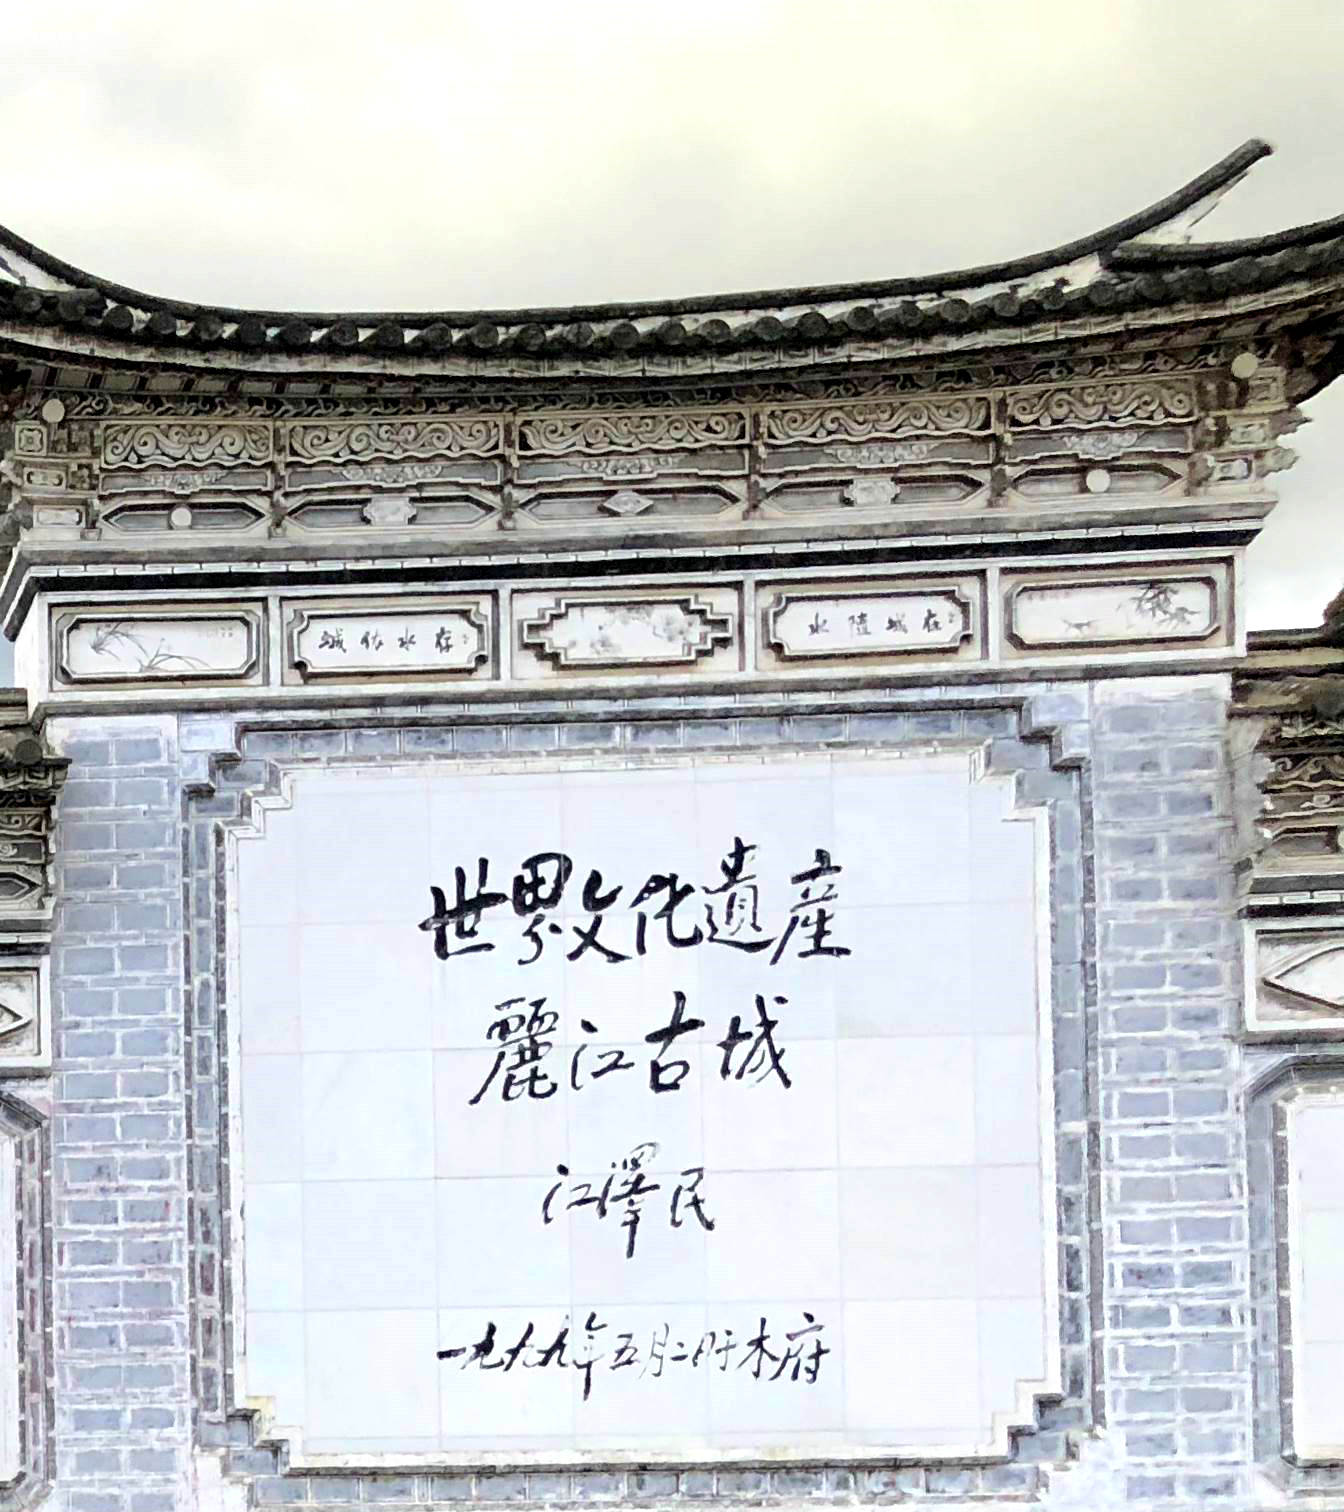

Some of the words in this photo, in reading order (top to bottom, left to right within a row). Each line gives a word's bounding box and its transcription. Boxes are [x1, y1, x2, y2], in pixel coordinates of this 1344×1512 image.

[469, 991, 792, 1105] 麗江古城
[543, 1143, 715, 1258] 江澤民
